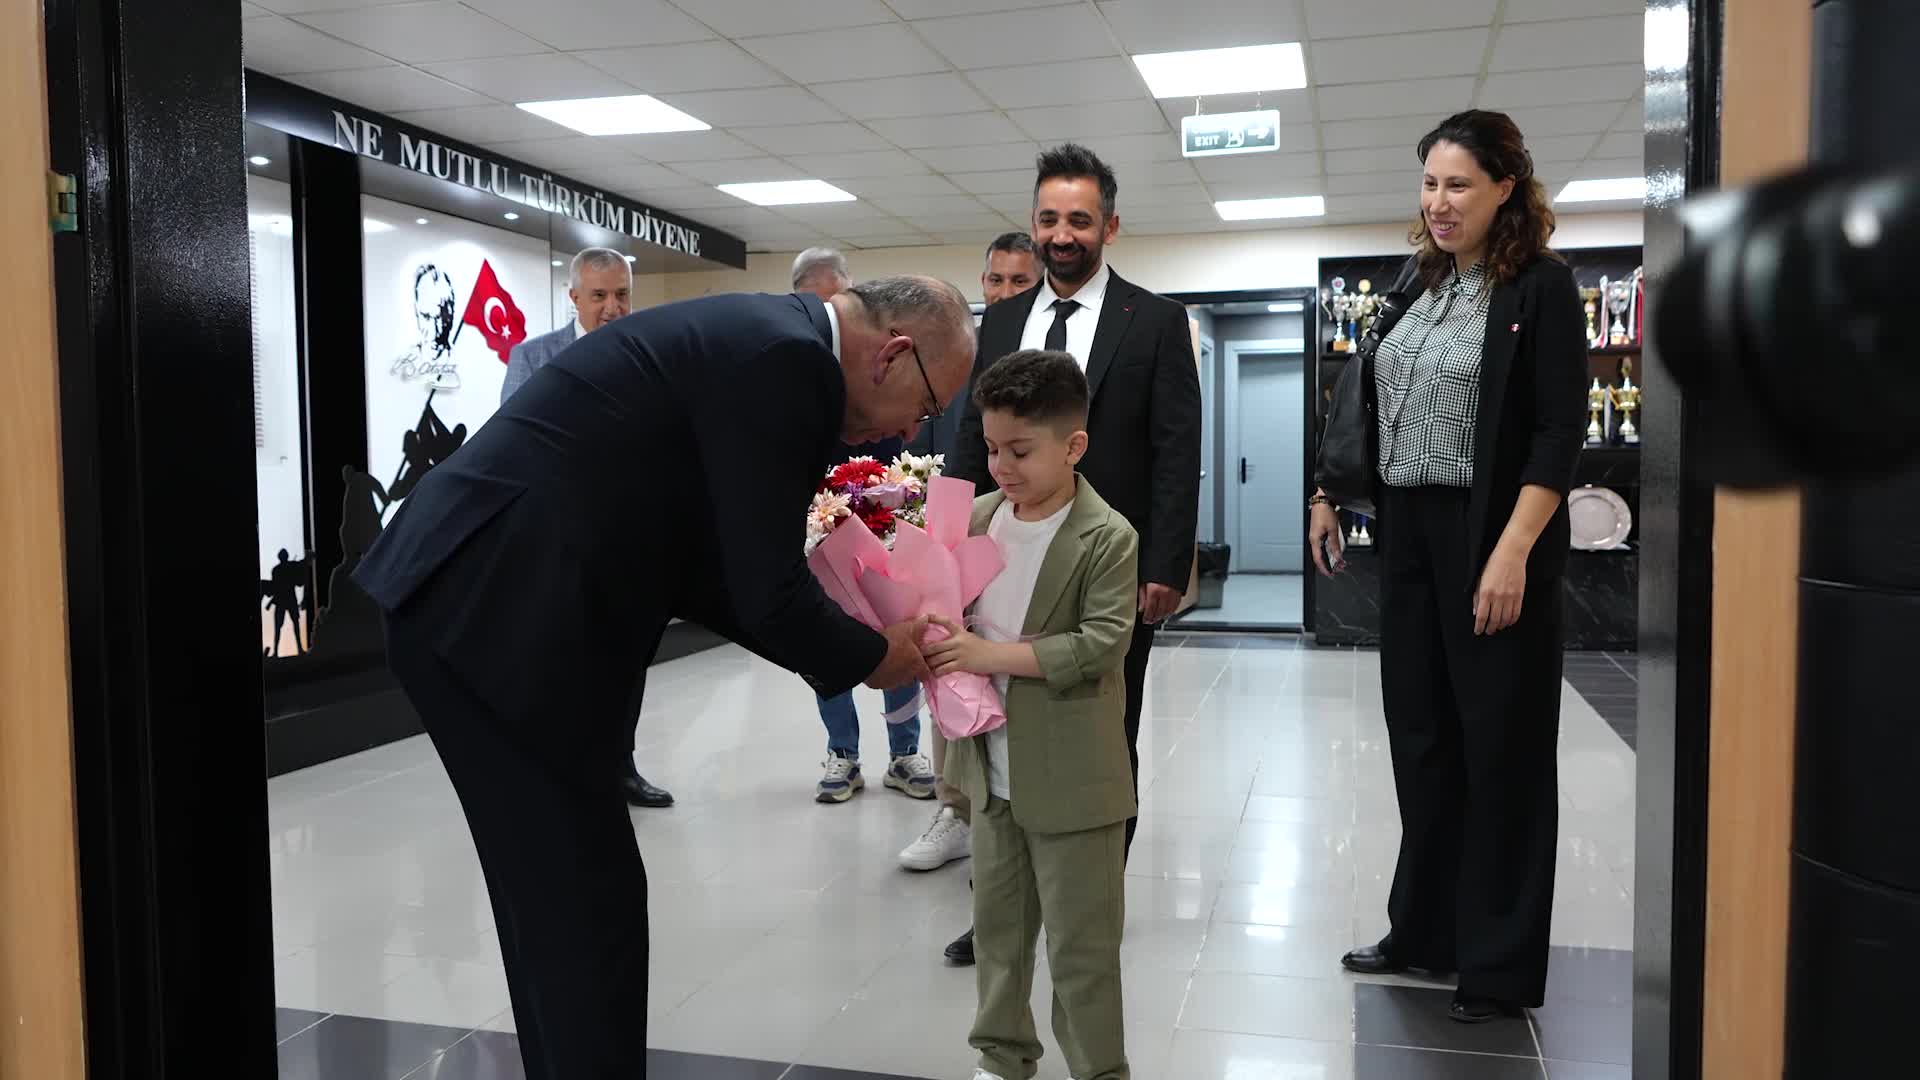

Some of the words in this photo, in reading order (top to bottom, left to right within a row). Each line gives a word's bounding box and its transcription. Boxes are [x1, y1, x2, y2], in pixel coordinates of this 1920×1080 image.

[1194, 135, 1220, 147] EXIT
[332, 110, 384, 161] NE
[398, 131, 509, 196] MUTLU
[520, 173, 625, 233] TÜRKÜM
[631, 208, 701, 257] DİYENE
